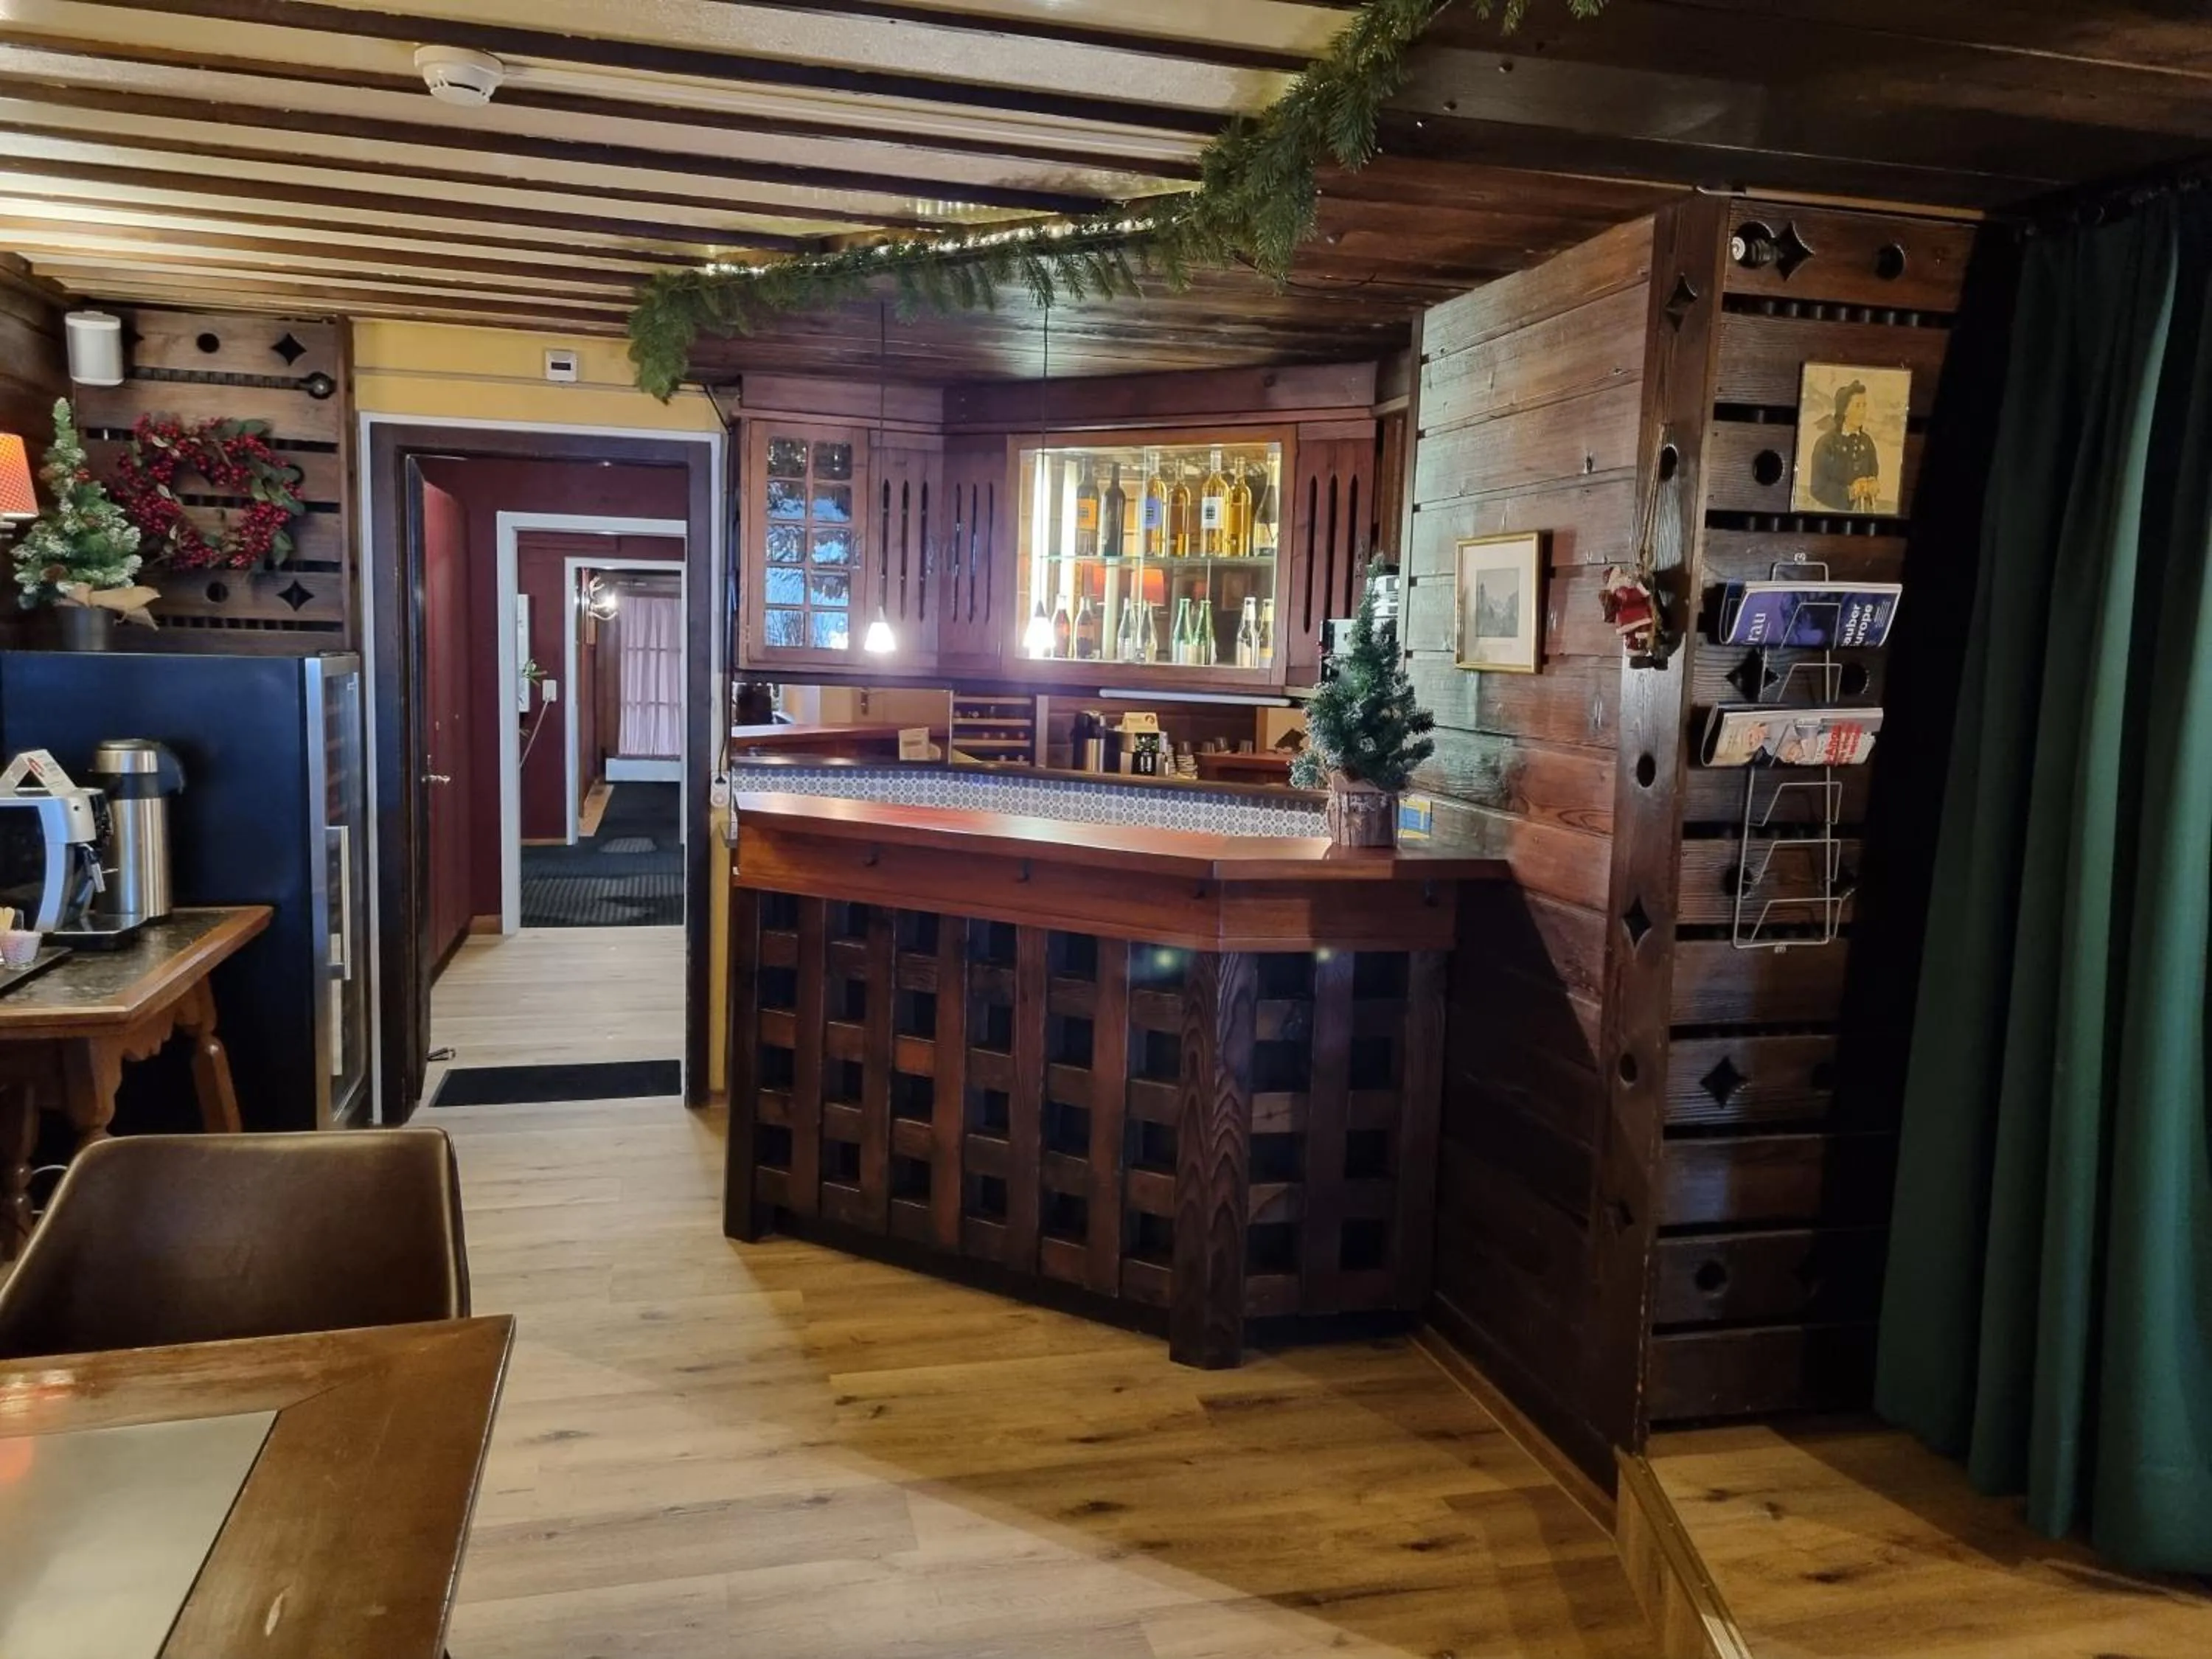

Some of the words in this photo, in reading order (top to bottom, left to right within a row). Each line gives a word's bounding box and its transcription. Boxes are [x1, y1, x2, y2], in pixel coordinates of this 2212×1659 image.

[1745, 612, 1767, 645] rau
[1841, 603, 1860, 646] auber
[1849, 604, 1874, 646] urope
